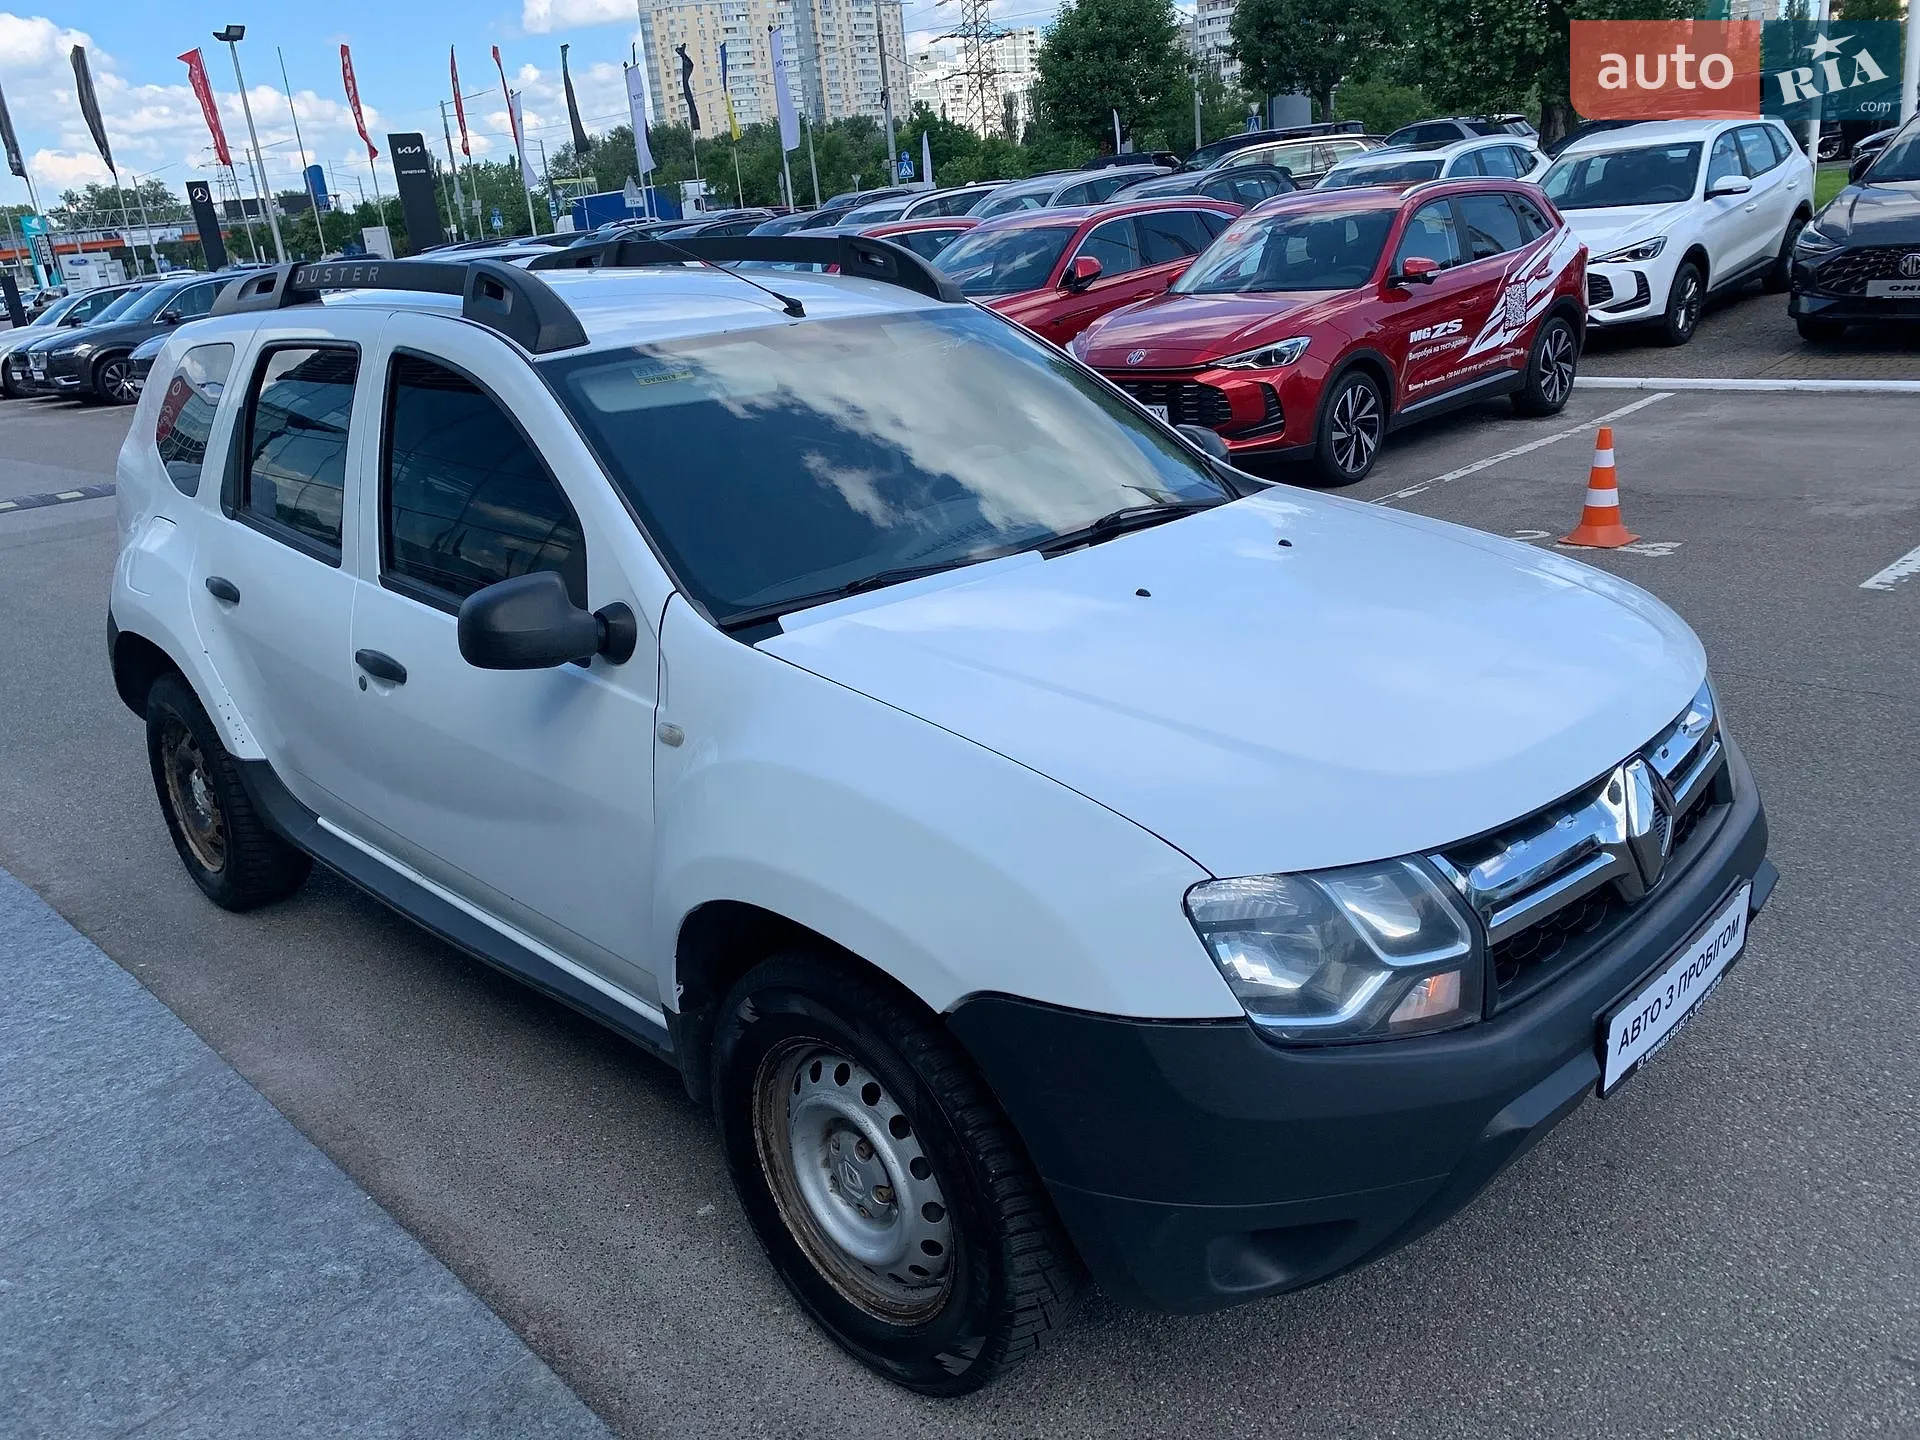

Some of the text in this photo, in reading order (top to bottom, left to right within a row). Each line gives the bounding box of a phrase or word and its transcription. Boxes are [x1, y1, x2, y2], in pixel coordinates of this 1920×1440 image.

[295, 266, 379, 285] DUSTER
[1409, 318, 1464, 343] MG ZS
[1618, 998, 1662, 1056] АВТО
[1664, 984, 1675, 1010] З
[1677, 913, 1741, 999] ПРОБІГОМ
